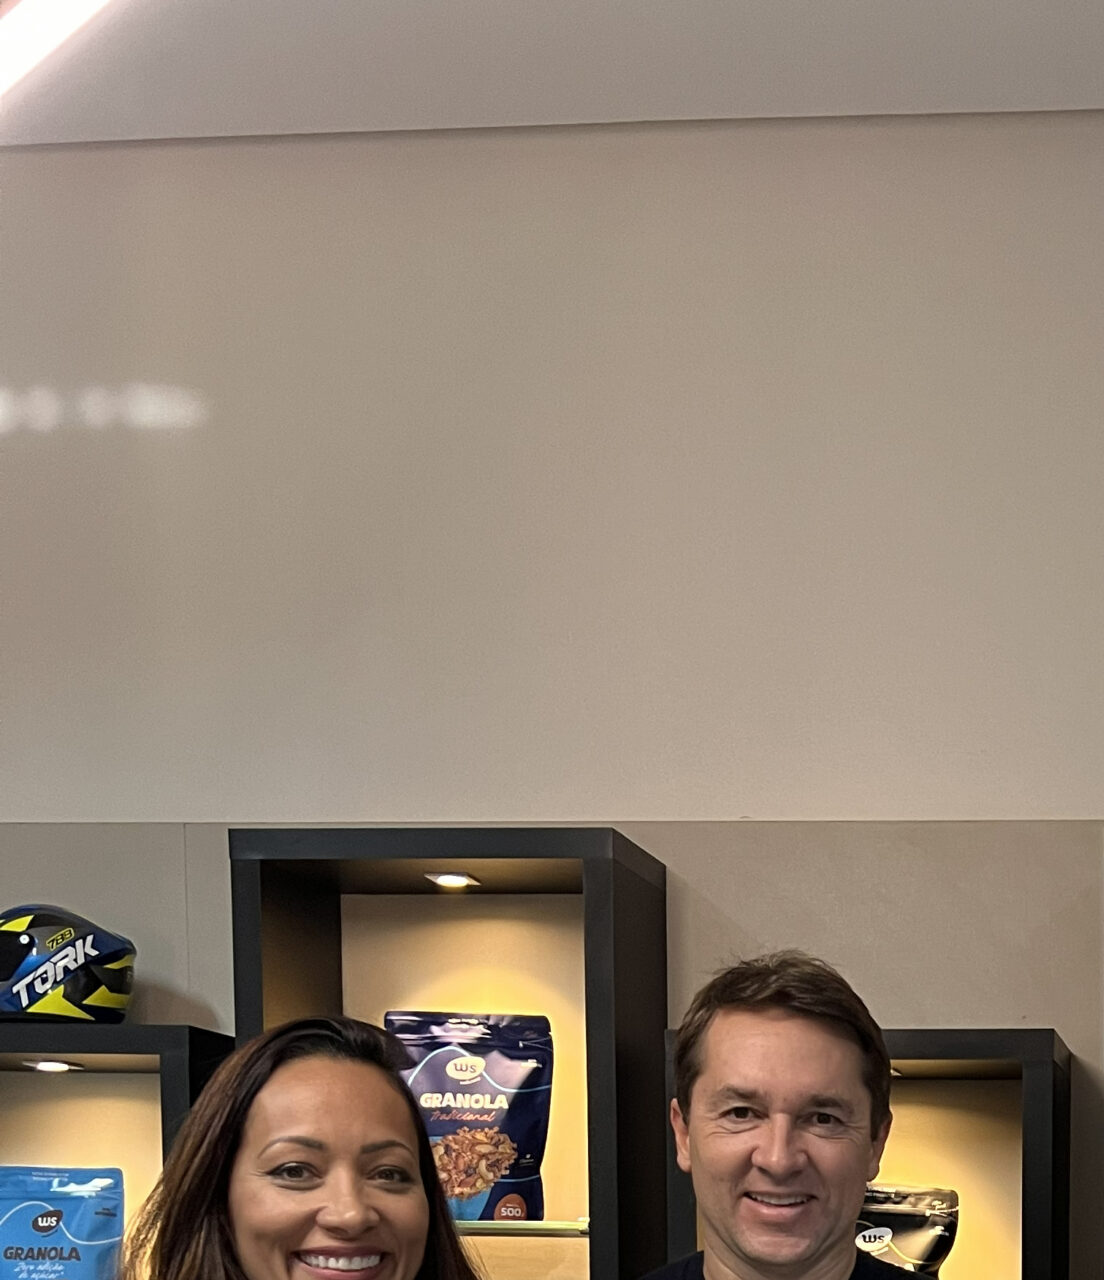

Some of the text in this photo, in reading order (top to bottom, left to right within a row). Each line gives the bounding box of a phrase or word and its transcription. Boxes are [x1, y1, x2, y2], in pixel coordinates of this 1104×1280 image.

[12, 934, 100, 1008] TORK
[419, 1092, 509, 1109] GRANOLA
[3, 1246, 81, 1262] GRANOLA
